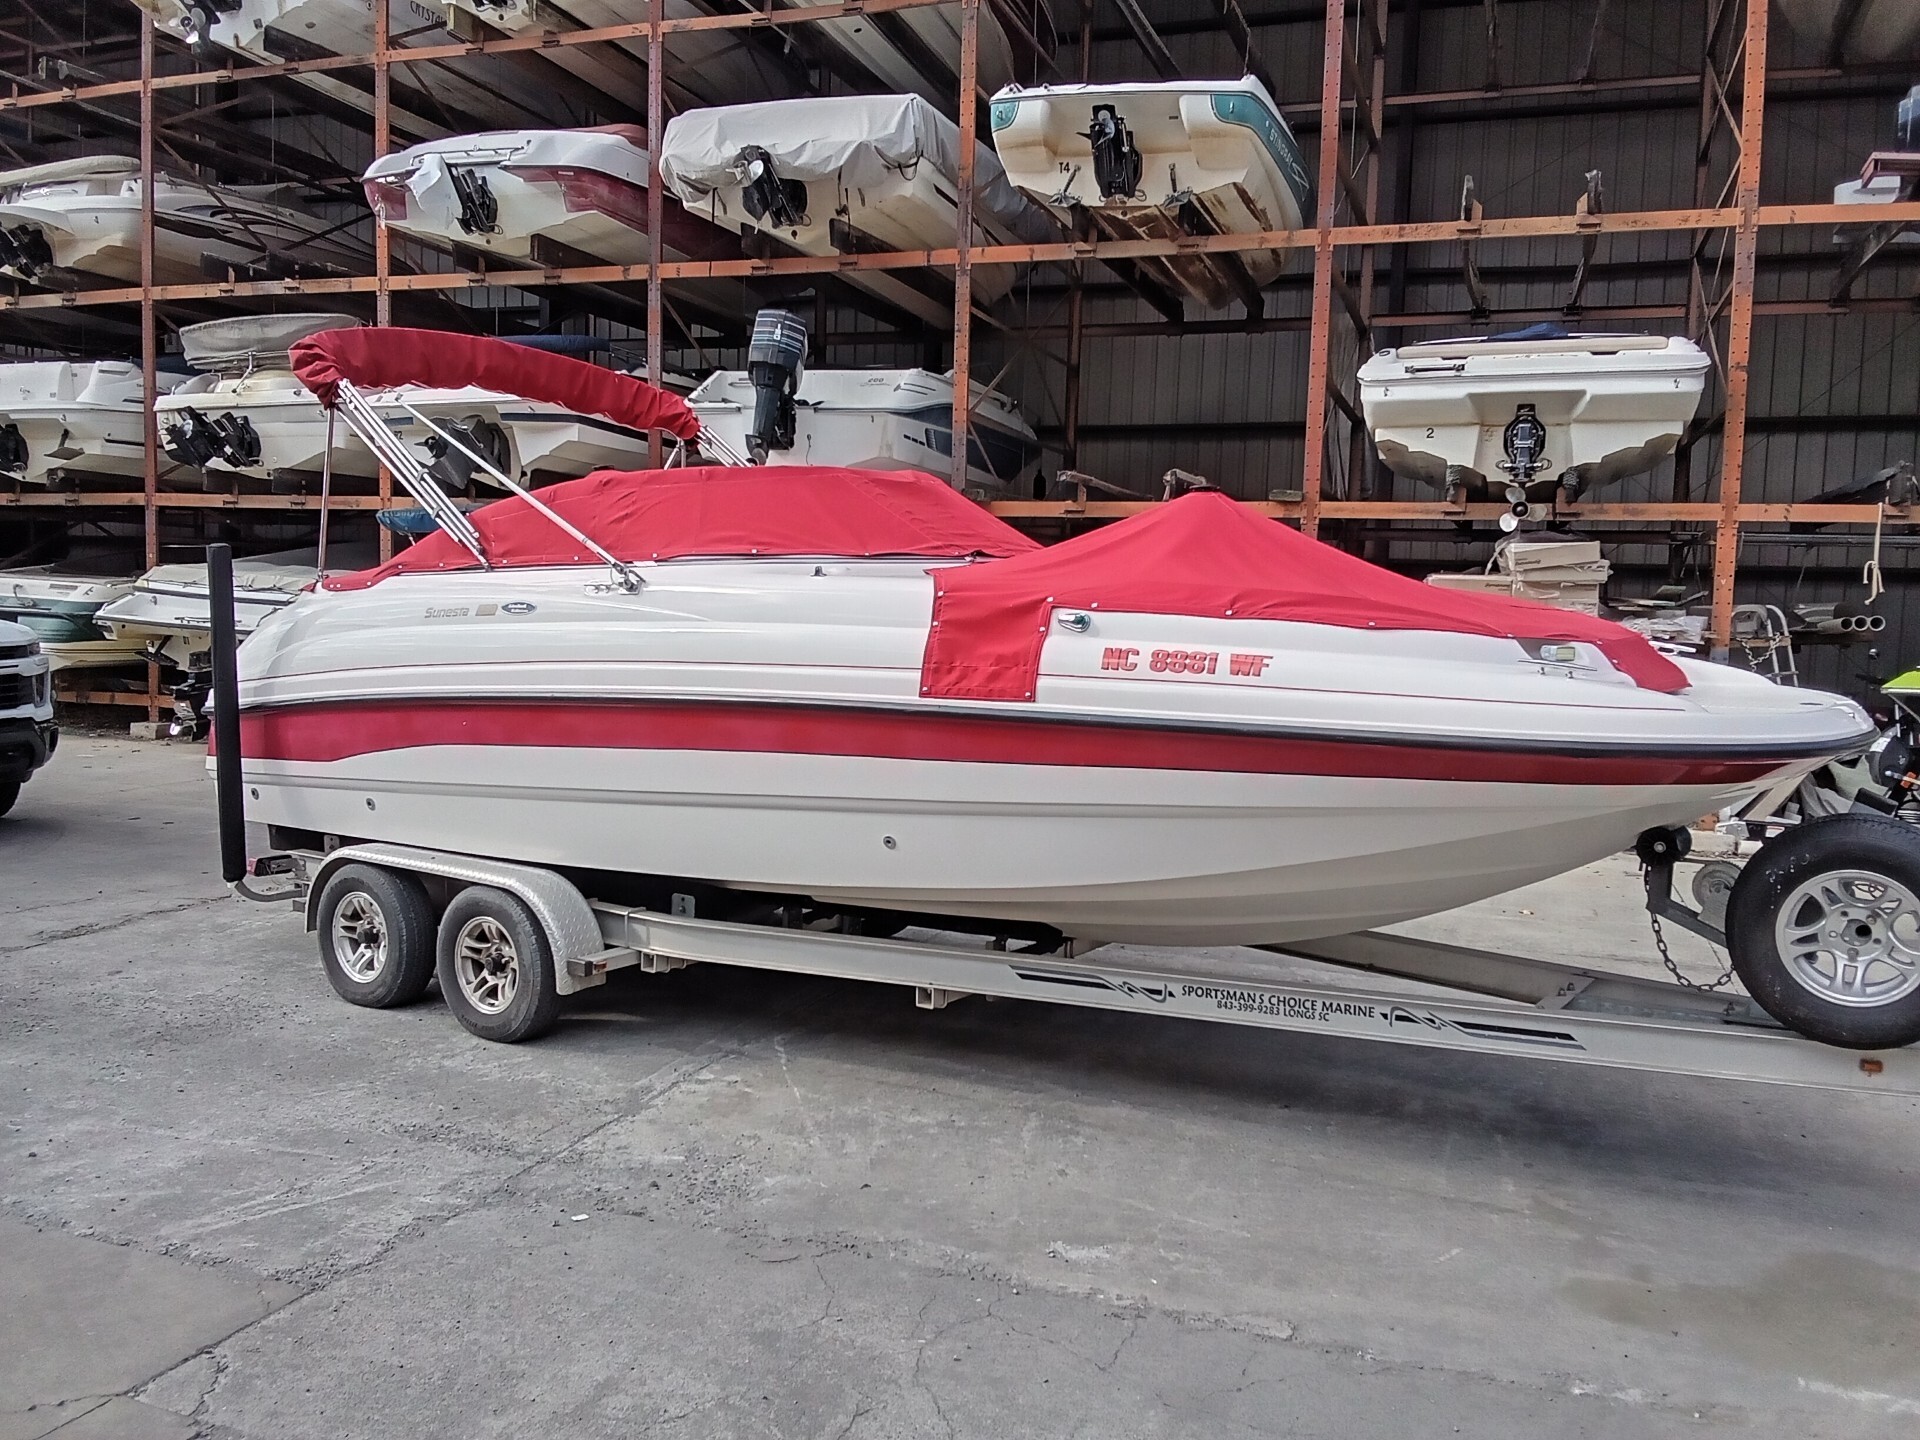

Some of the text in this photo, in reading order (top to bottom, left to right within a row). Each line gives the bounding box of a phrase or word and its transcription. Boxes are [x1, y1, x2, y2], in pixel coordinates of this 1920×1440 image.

[1058, 161, 1071, 174] T4
[1425, 427, 1435, 439] 2
[424, 606, 470, 619] Sunesta
[1100, 647, 1274, 677] NC 8881 WF
[1216, 1000, 1330, 1022] 843-399-9283 LONGS SC
[1268, 994, 1318, 1012] CHOICE
[1321, 1000, 1375, 1018] MARINE
